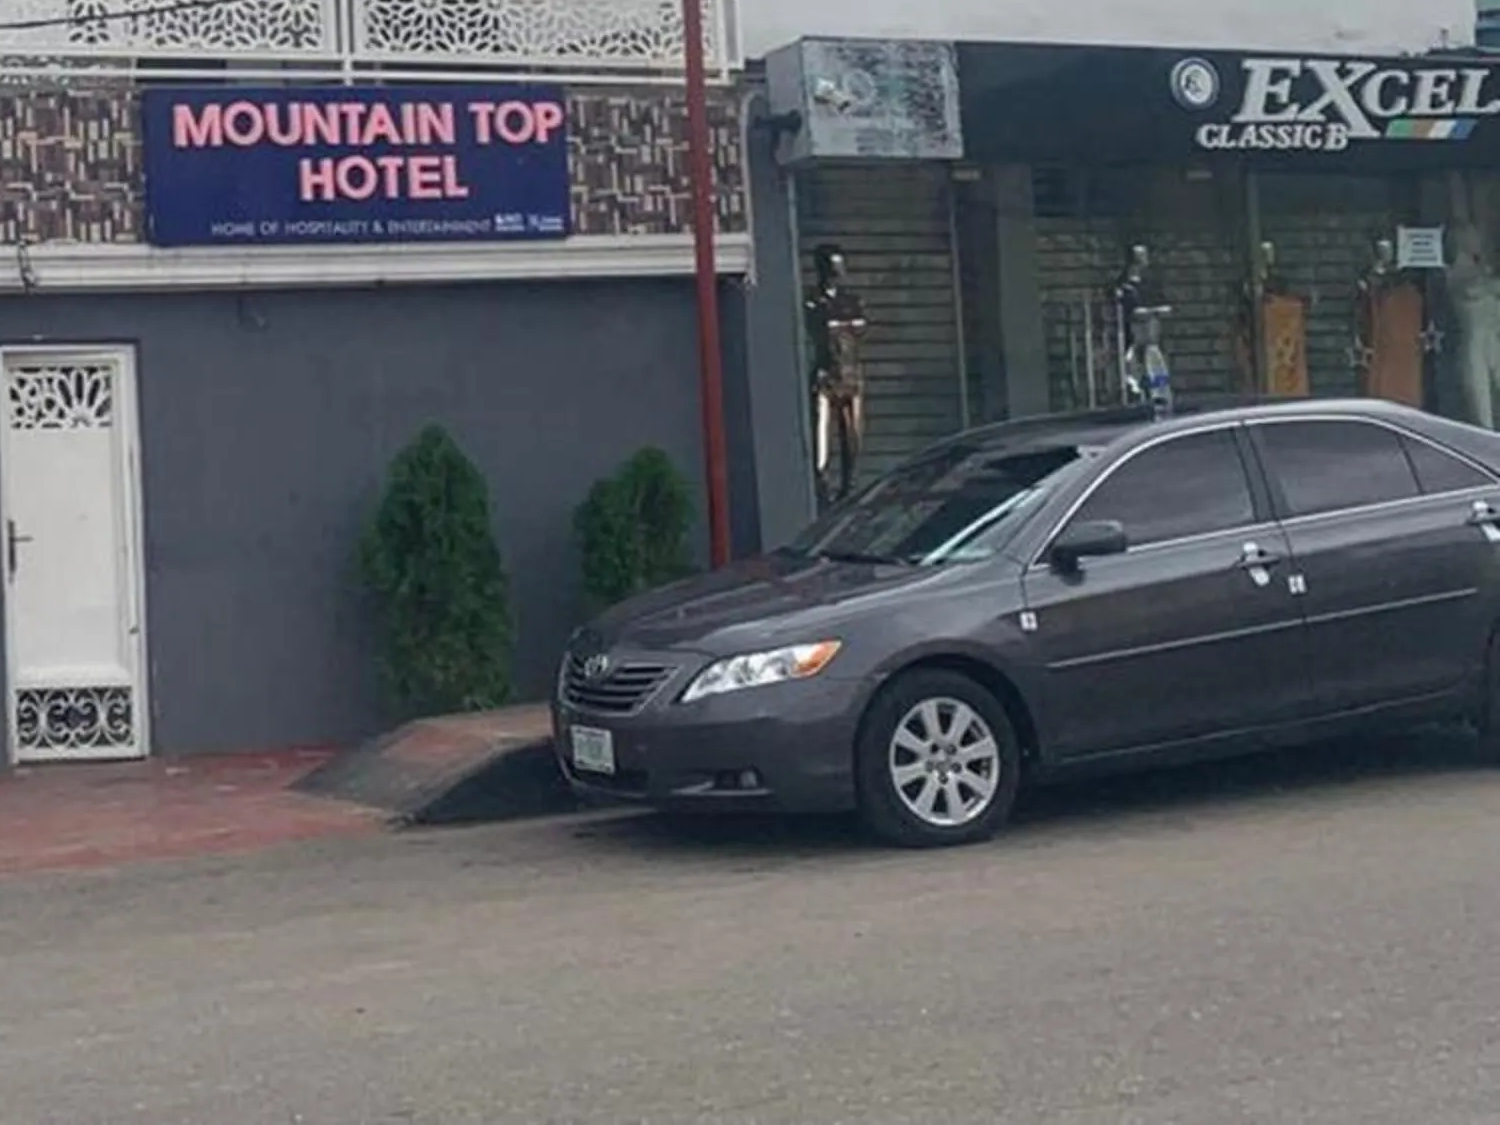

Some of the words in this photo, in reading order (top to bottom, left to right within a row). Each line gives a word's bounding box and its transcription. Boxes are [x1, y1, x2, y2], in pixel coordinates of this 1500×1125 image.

[1232, 59, 1500, 138] EXCEL
[173, 101, 455, 147] MOUNTAIN
[469, 100, 563, 144] TOP
[301, 156, 468, 201] HOTEL
[260, 221, 278, 236] OF
